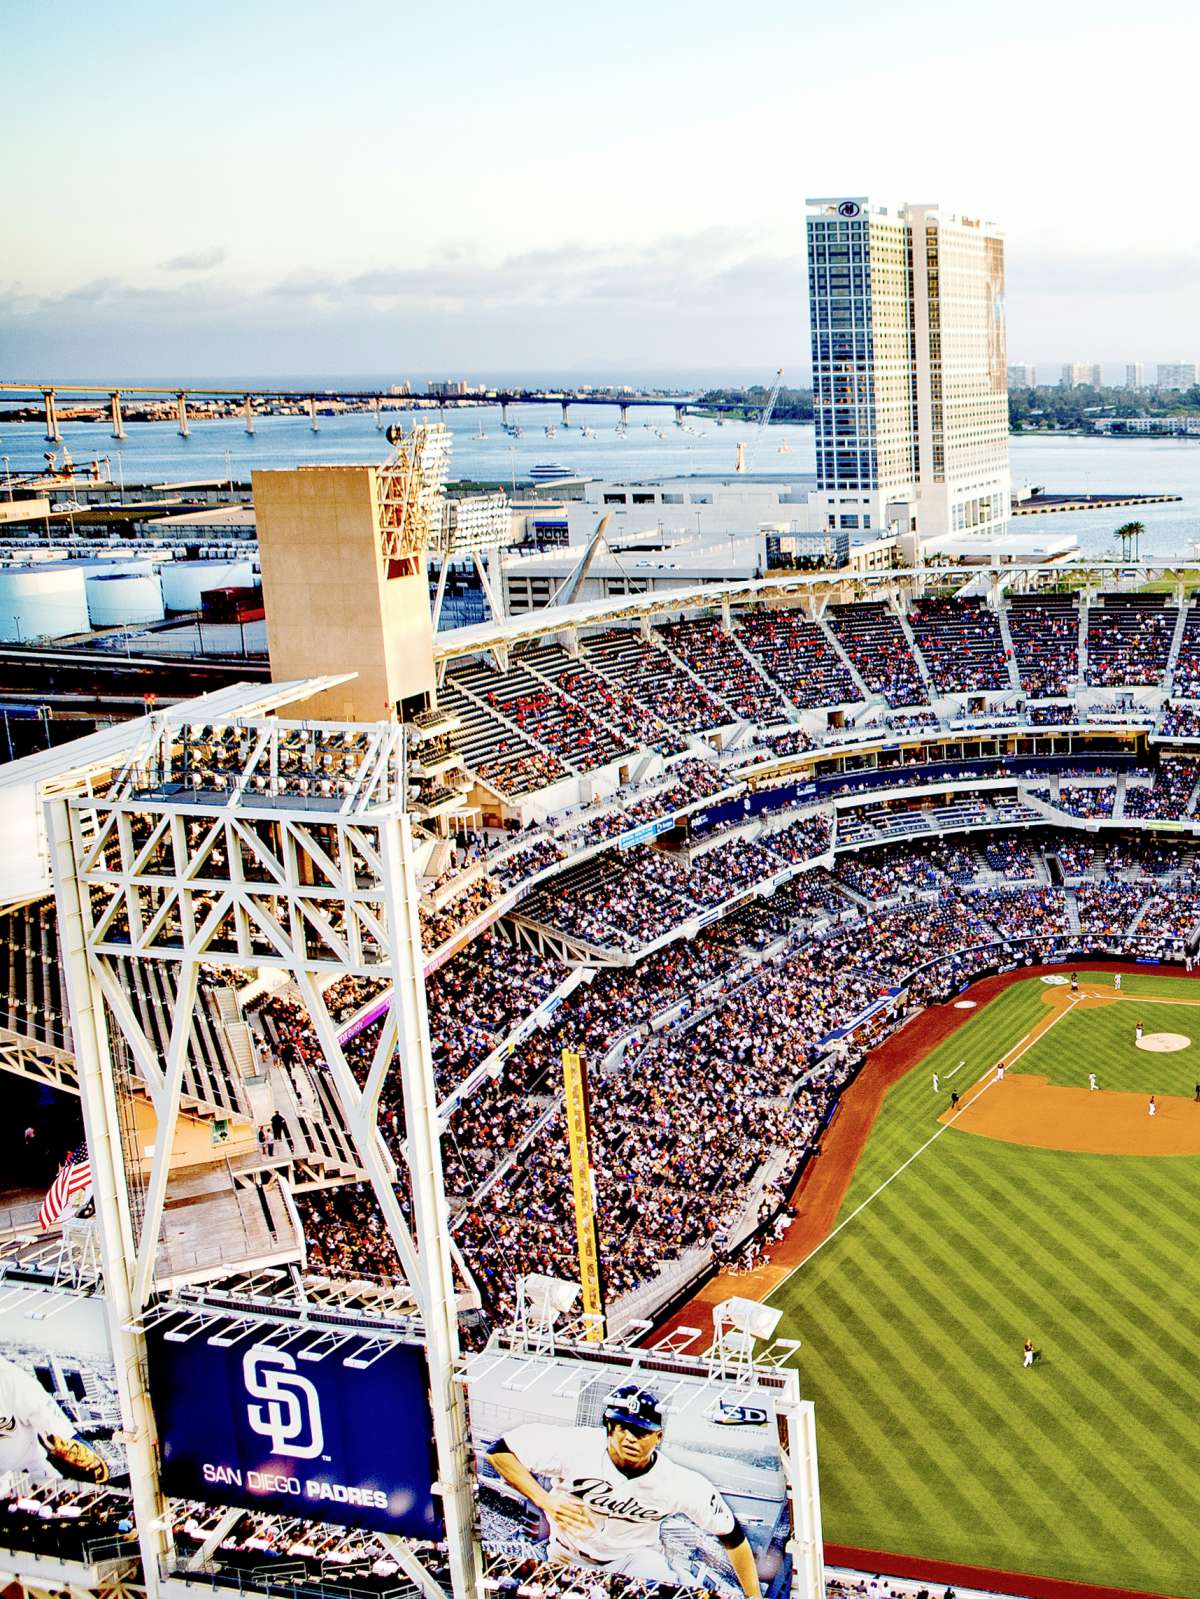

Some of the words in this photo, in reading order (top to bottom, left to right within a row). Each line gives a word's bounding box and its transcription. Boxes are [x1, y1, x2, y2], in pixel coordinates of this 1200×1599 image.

[202, 1463, 242, 1488] SAN
[246, 1470, 302, 1496] DIEGO
[304, 1479, 389, 1510] PADRES
